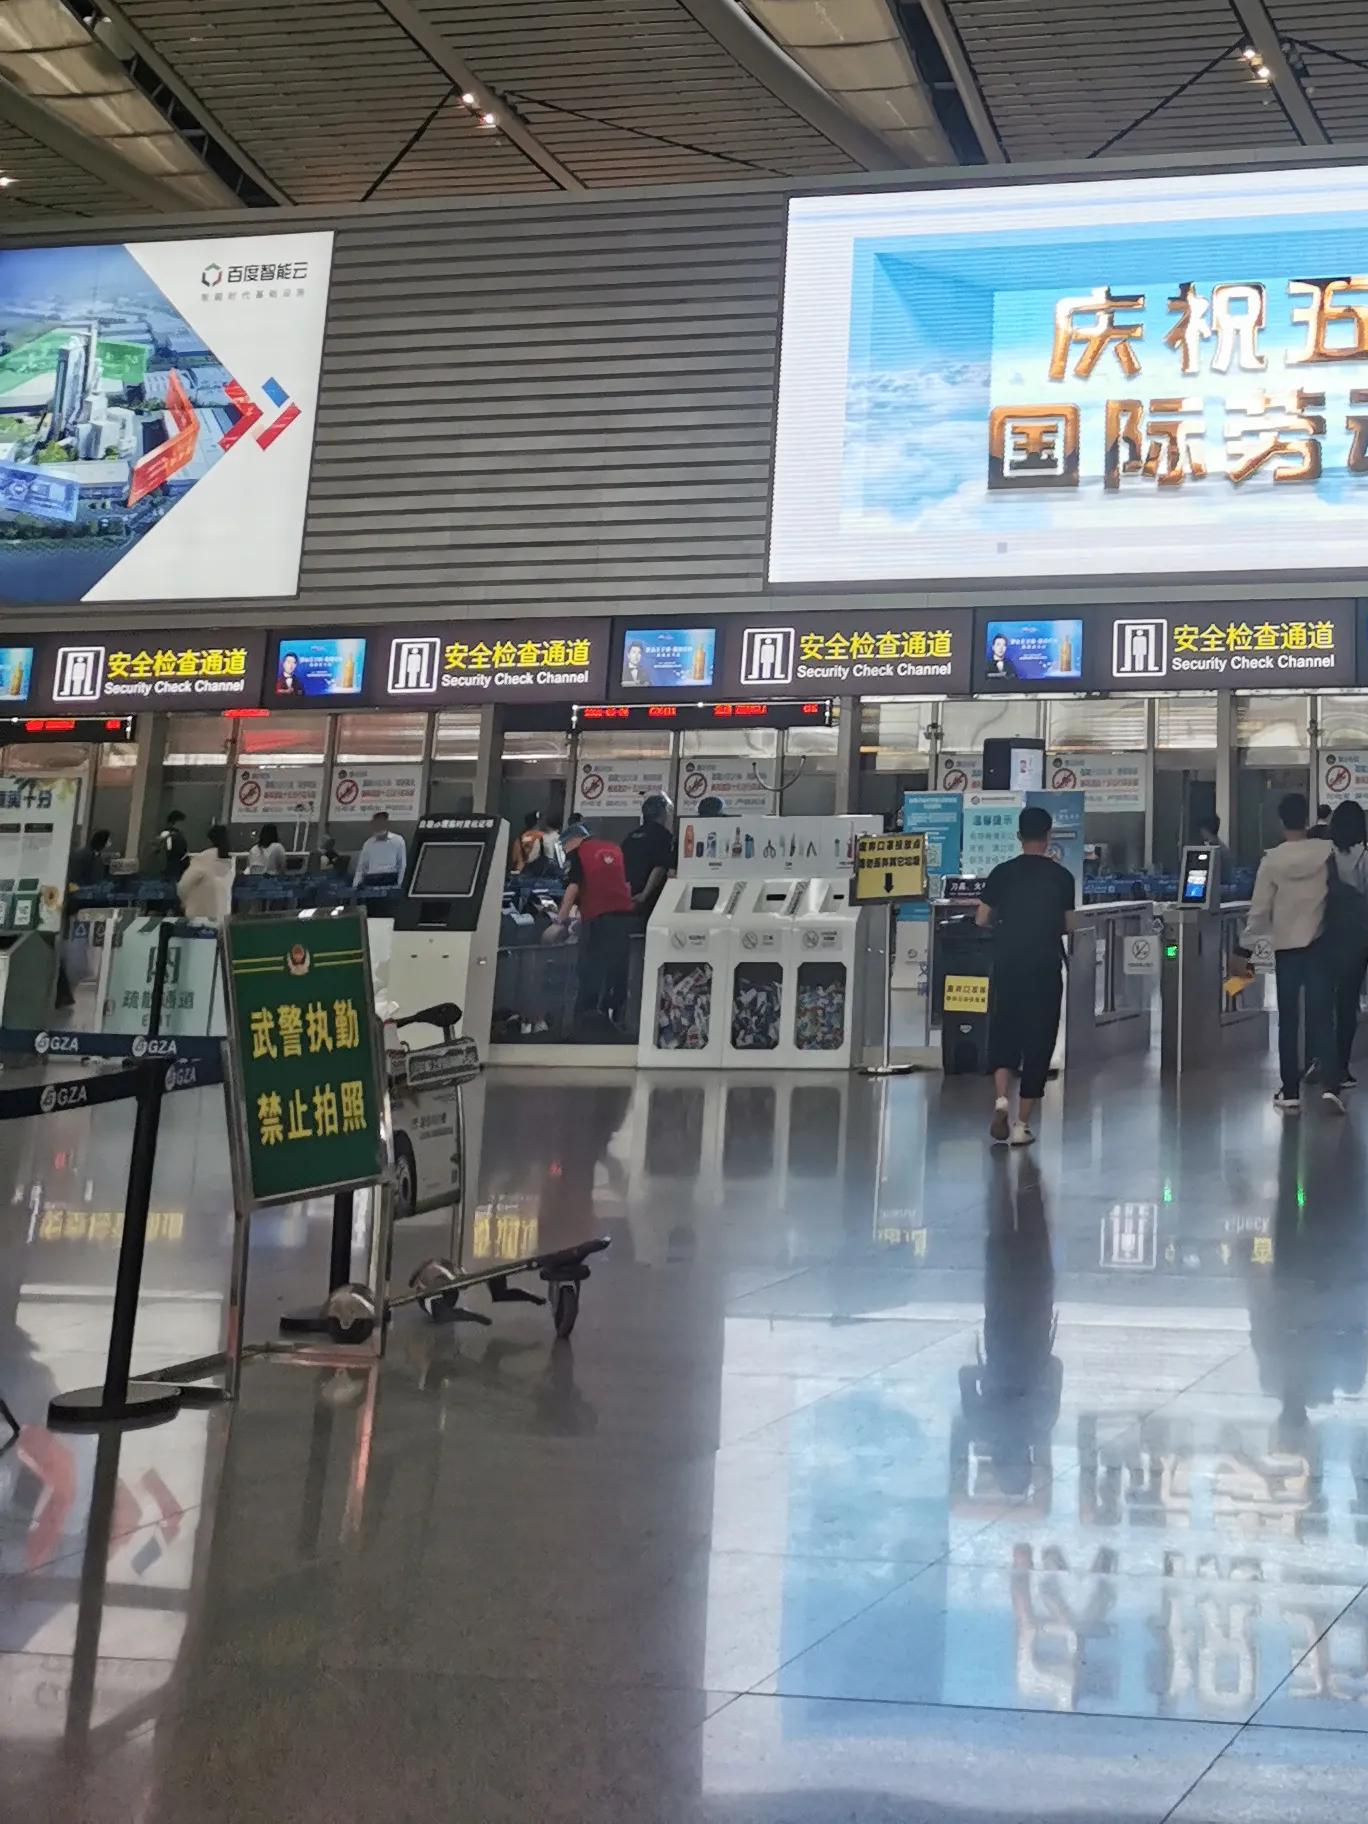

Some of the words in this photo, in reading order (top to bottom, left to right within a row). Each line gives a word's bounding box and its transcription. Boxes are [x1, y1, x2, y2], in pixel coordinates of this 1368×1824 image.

[228, 262, 308, 283] 百度智能云
[800, 631, 952, 661] 安全检查通道
[1174, 621, 1335, 652] 安全检查通道
[107, 648, 247, 678] 安全检查通道
[444, 639, 591, 670] 安全检查通道
[1172, 657, 1227, 672] Security
[1231, 656, 1274, 669] Check
[1278, 654, 1335, 669] Channel
[441, 674, 491, 689] Security
[495, 672, 533, 685] Check
[537, 671, 588, 684] Channel
[797, 665, 848, 680] Security
[853, 663, 893, 677] Check
[897, 662, 951, 676] Channel
[104, 681, 151, 696] Security
[155, 680, 191, 693] Check
[194, 679, 244, 693] Channel
[250, 998, 360, 1061] 武警执勤
[50, 1033, 79, 1052] GZA
[148, 1040, 177, 1055] GZA
[176, 1066, 197, 1086] GZA
[57, 1085, 88, 1106] GZA
[257, 1080, 367, 1146] 禁止拍照
